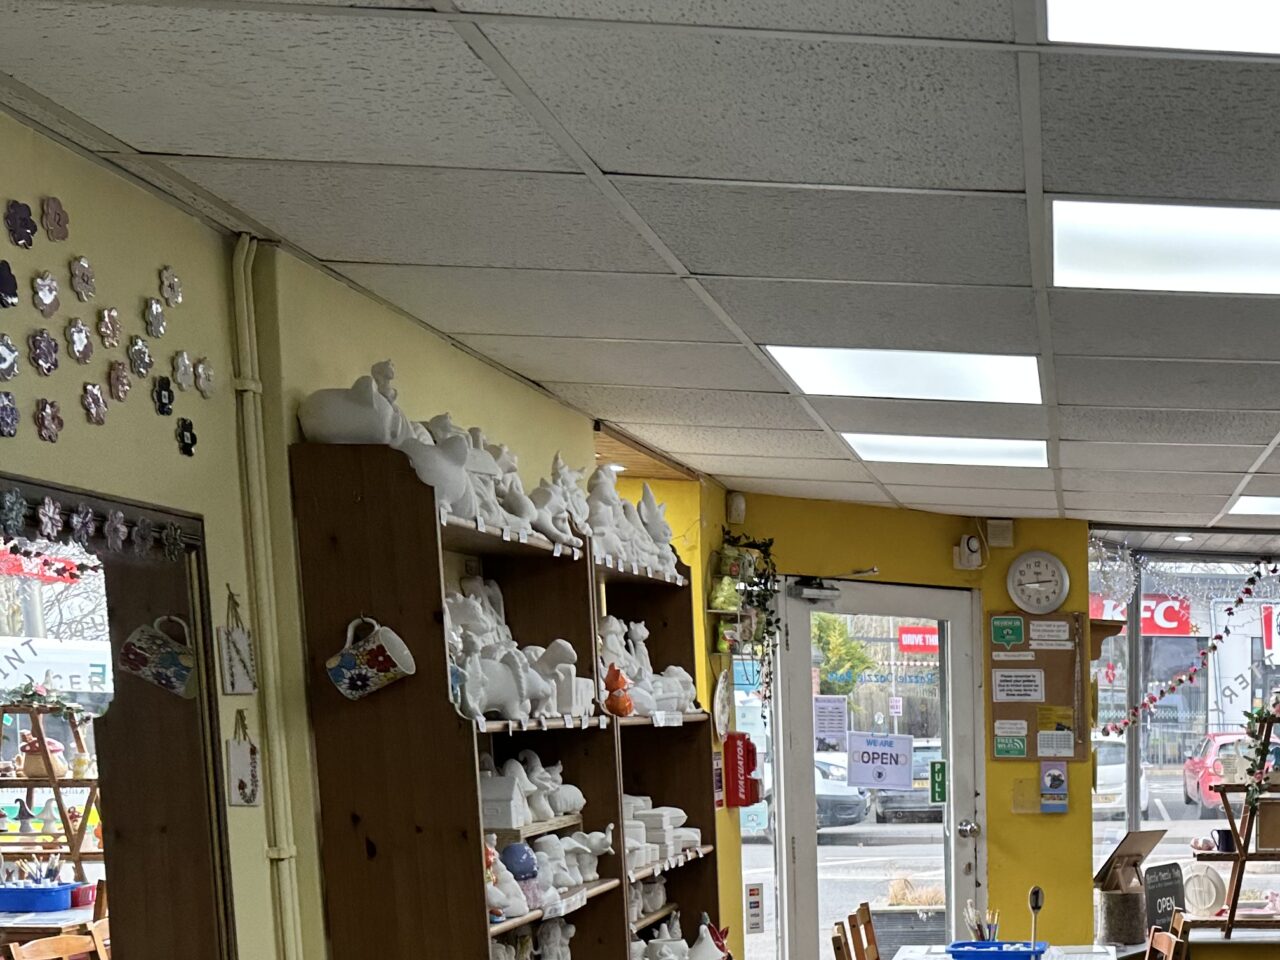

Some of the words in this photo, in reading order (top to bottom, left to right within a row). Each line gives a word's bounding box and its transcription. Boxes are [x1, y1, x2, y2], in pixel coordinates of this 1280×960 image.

[1102, 599, 1180, 628] KFC
[736, 739, 746, 800] EVACUATOR
[861, 751, 899, 766] OPEN
[1157, 896, 1176, 914] OPEN
